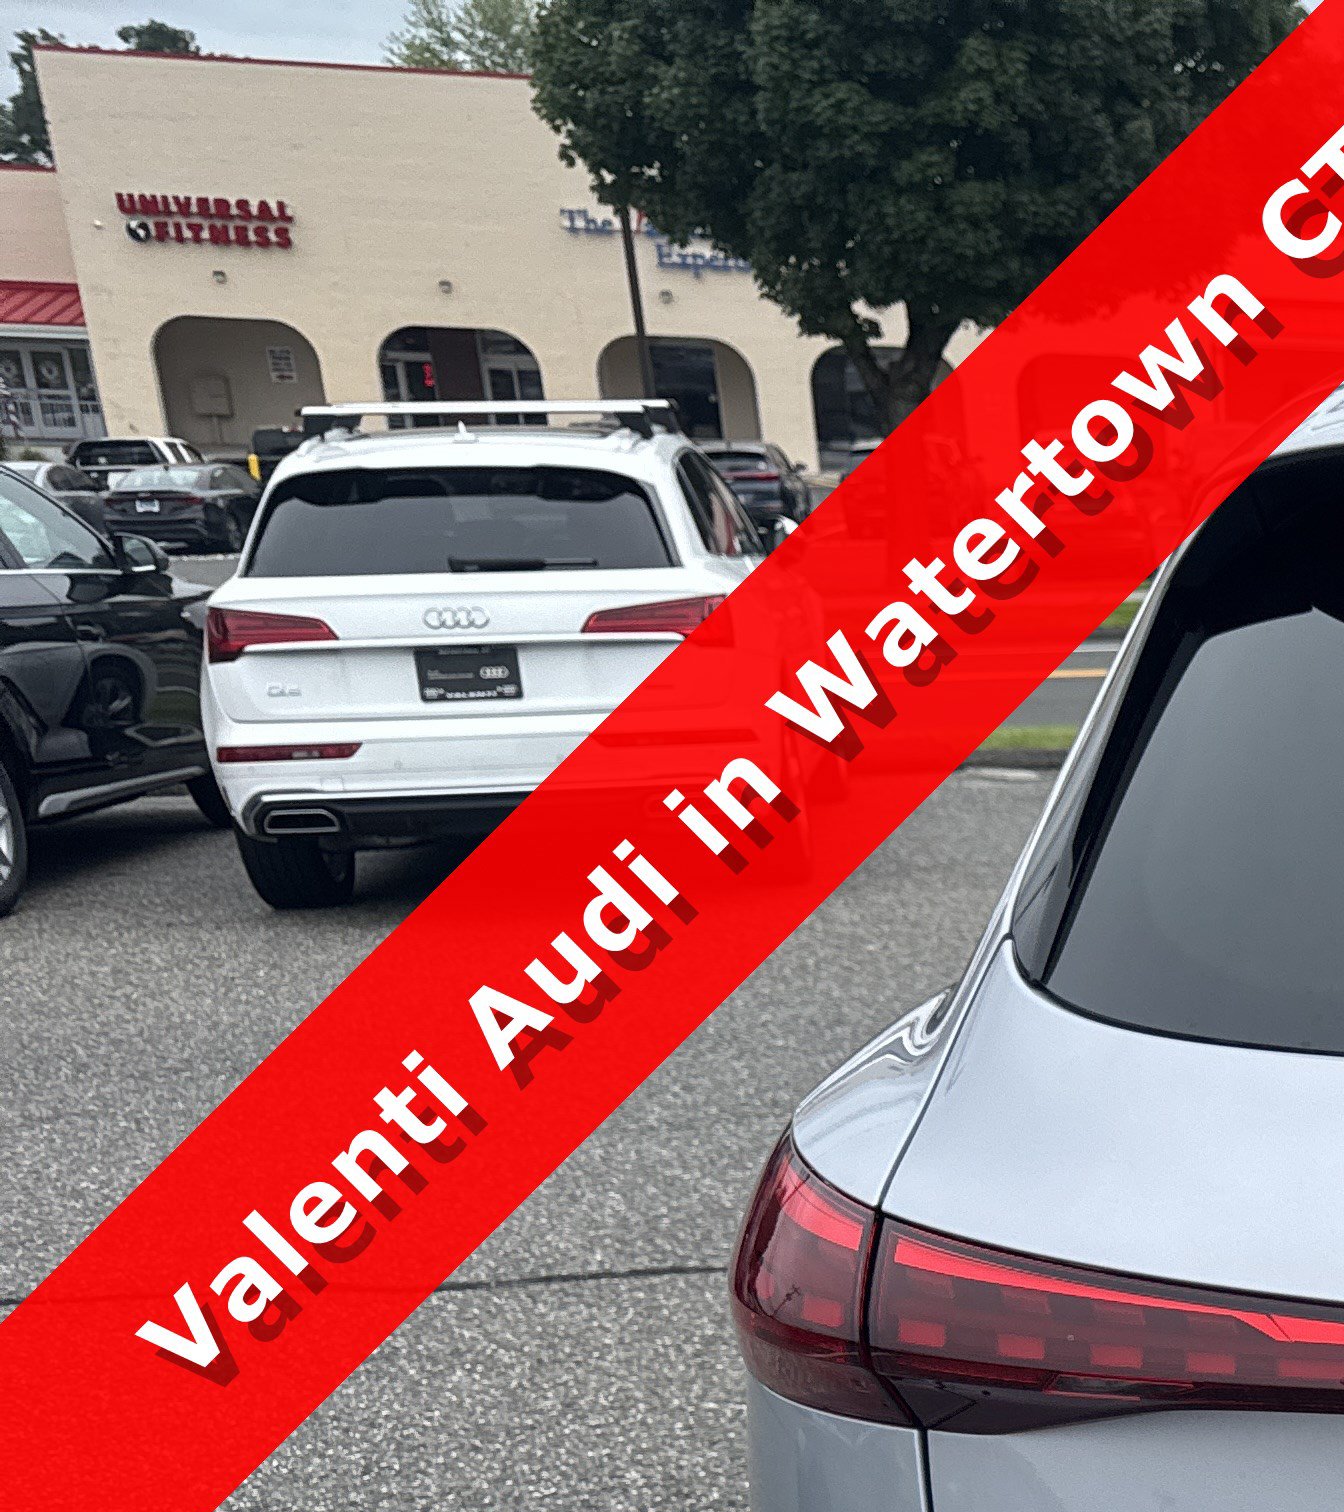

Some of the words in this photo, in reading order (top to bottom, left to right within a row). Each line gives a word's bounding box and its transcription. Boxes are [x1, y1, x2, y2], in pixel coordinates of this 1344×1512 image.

[115, 192, 294, 223] UNIVERSAL
[560, 208, 614, 234] The
[153, 220, 293, 249] FITNESS
